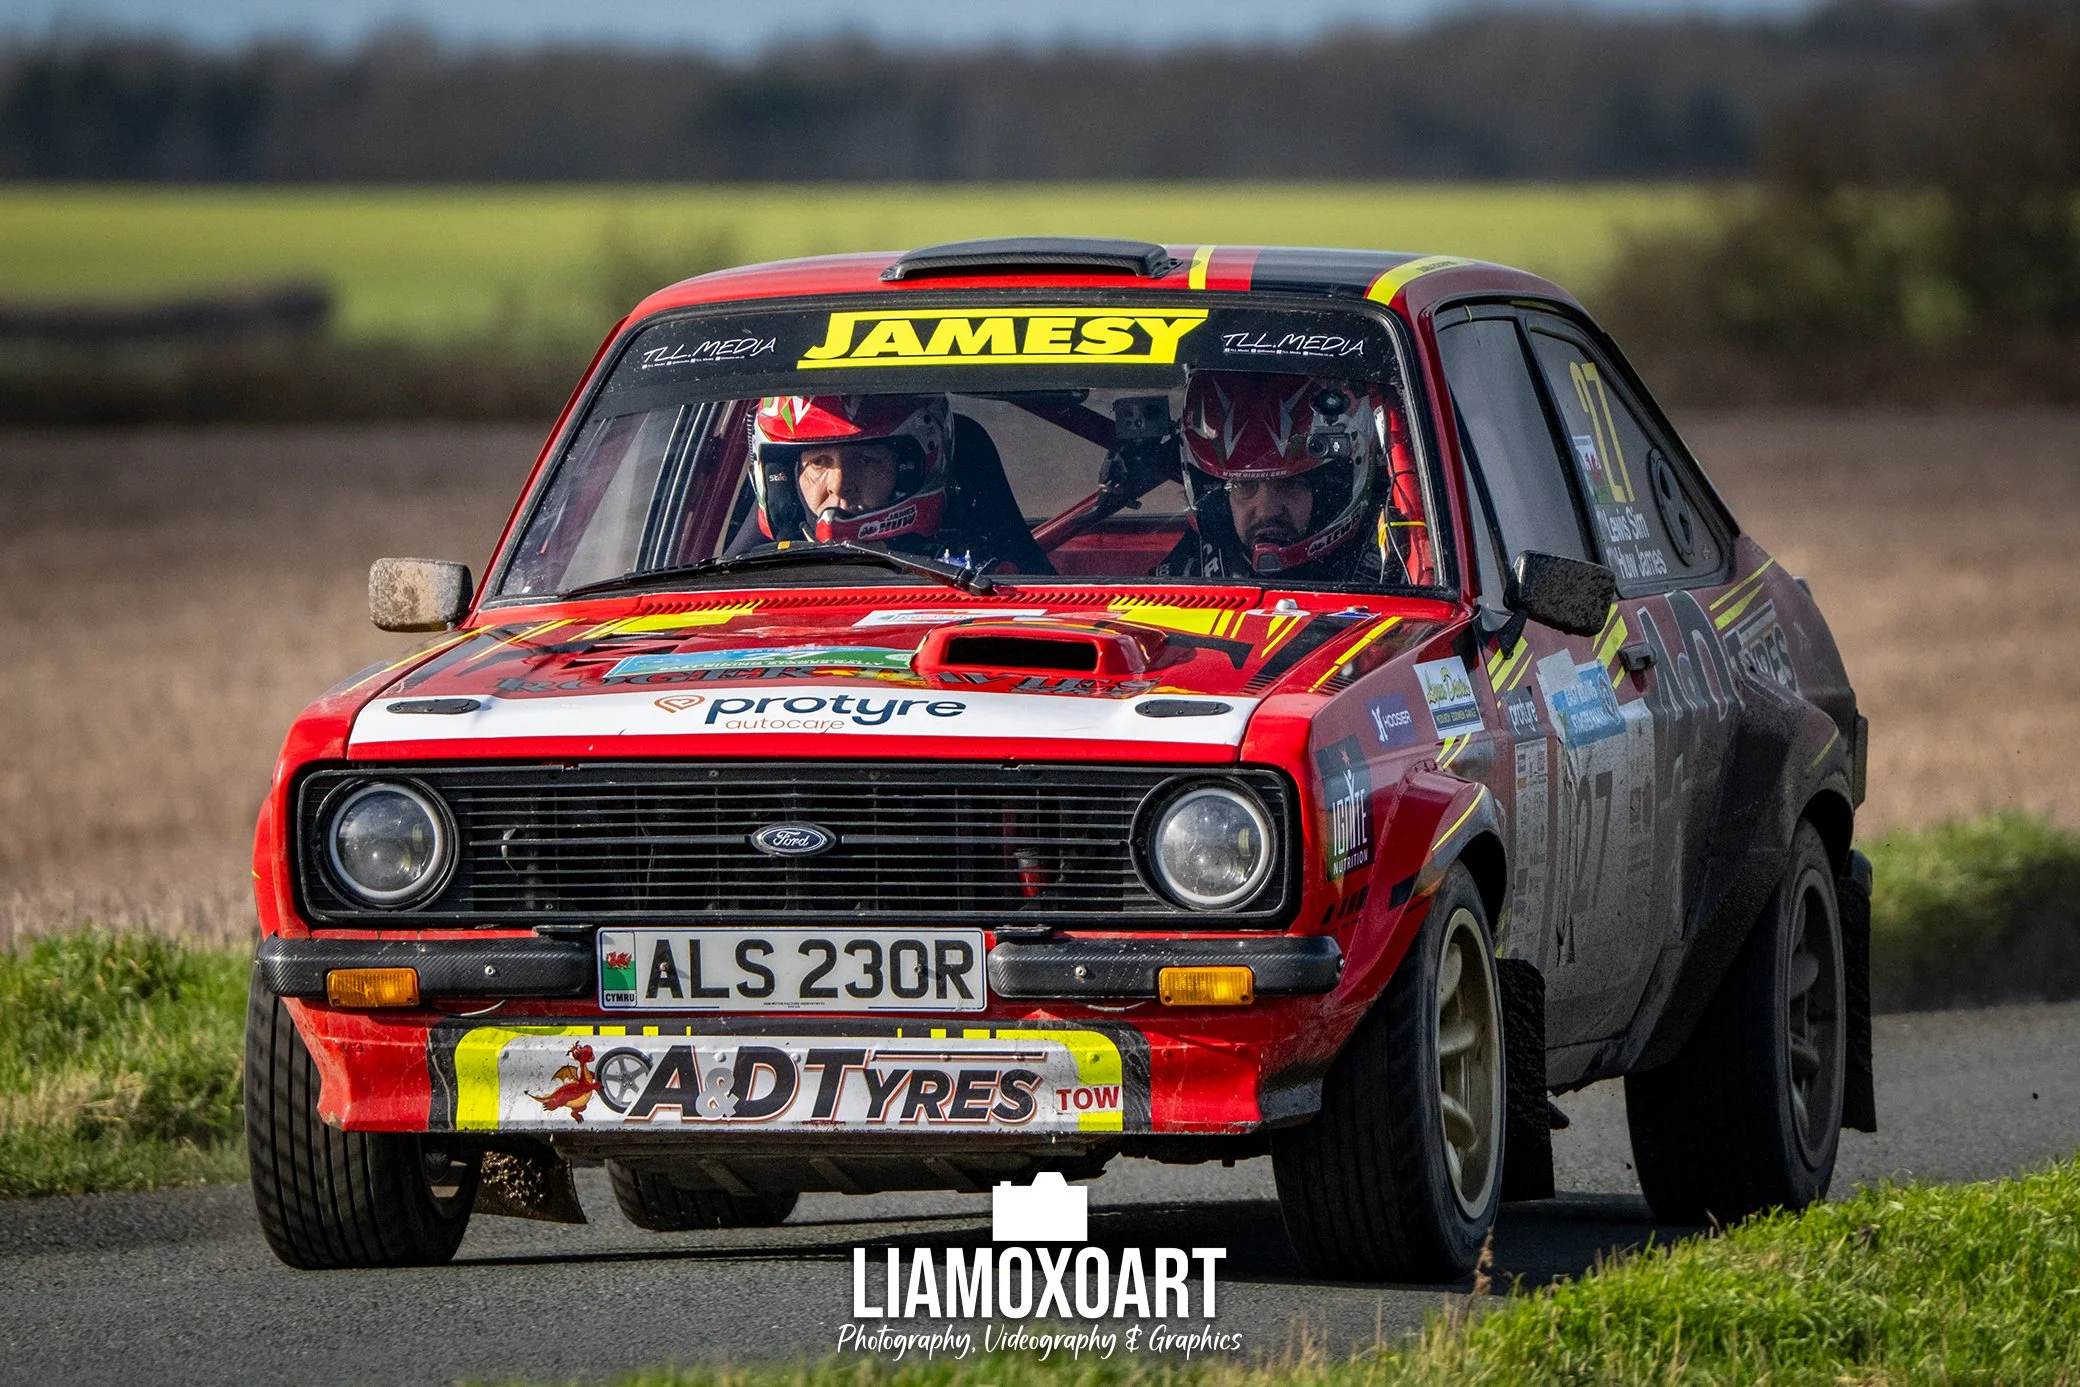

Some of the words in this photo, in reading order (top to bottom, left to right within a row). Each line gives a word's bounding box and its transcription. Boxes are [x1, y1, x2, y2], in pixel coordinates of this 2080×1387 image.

[797, 308, 1209, 369] JAMESY
[1569, 361, 1636, 503] 27
[1603, 509, 1632, 543] Lewis
[1625, 505, 1650, 539] Sim
[1614, 546, 1637, 580] Huw
[1634, 544, 1668, 579] James
[705, 694, 967, 726] protyre
[726, 717, 845, 731] autocare
[1383, 709, 1413, 729] HOOSIER
[1508, 697, 1539, 736] protyre
[1332, 785, 1368, 857] IGNITE
[772, 830, 810, 847] Ford
[1332, 849, 1369, 876] NUTRITION
[645, 938, 776, 1000] ALS
[797, 938, 975, 1000] 230R
[605, 991, 636, 1003] CYMRU
[1056, 1085, 1120, 1111] TOW
